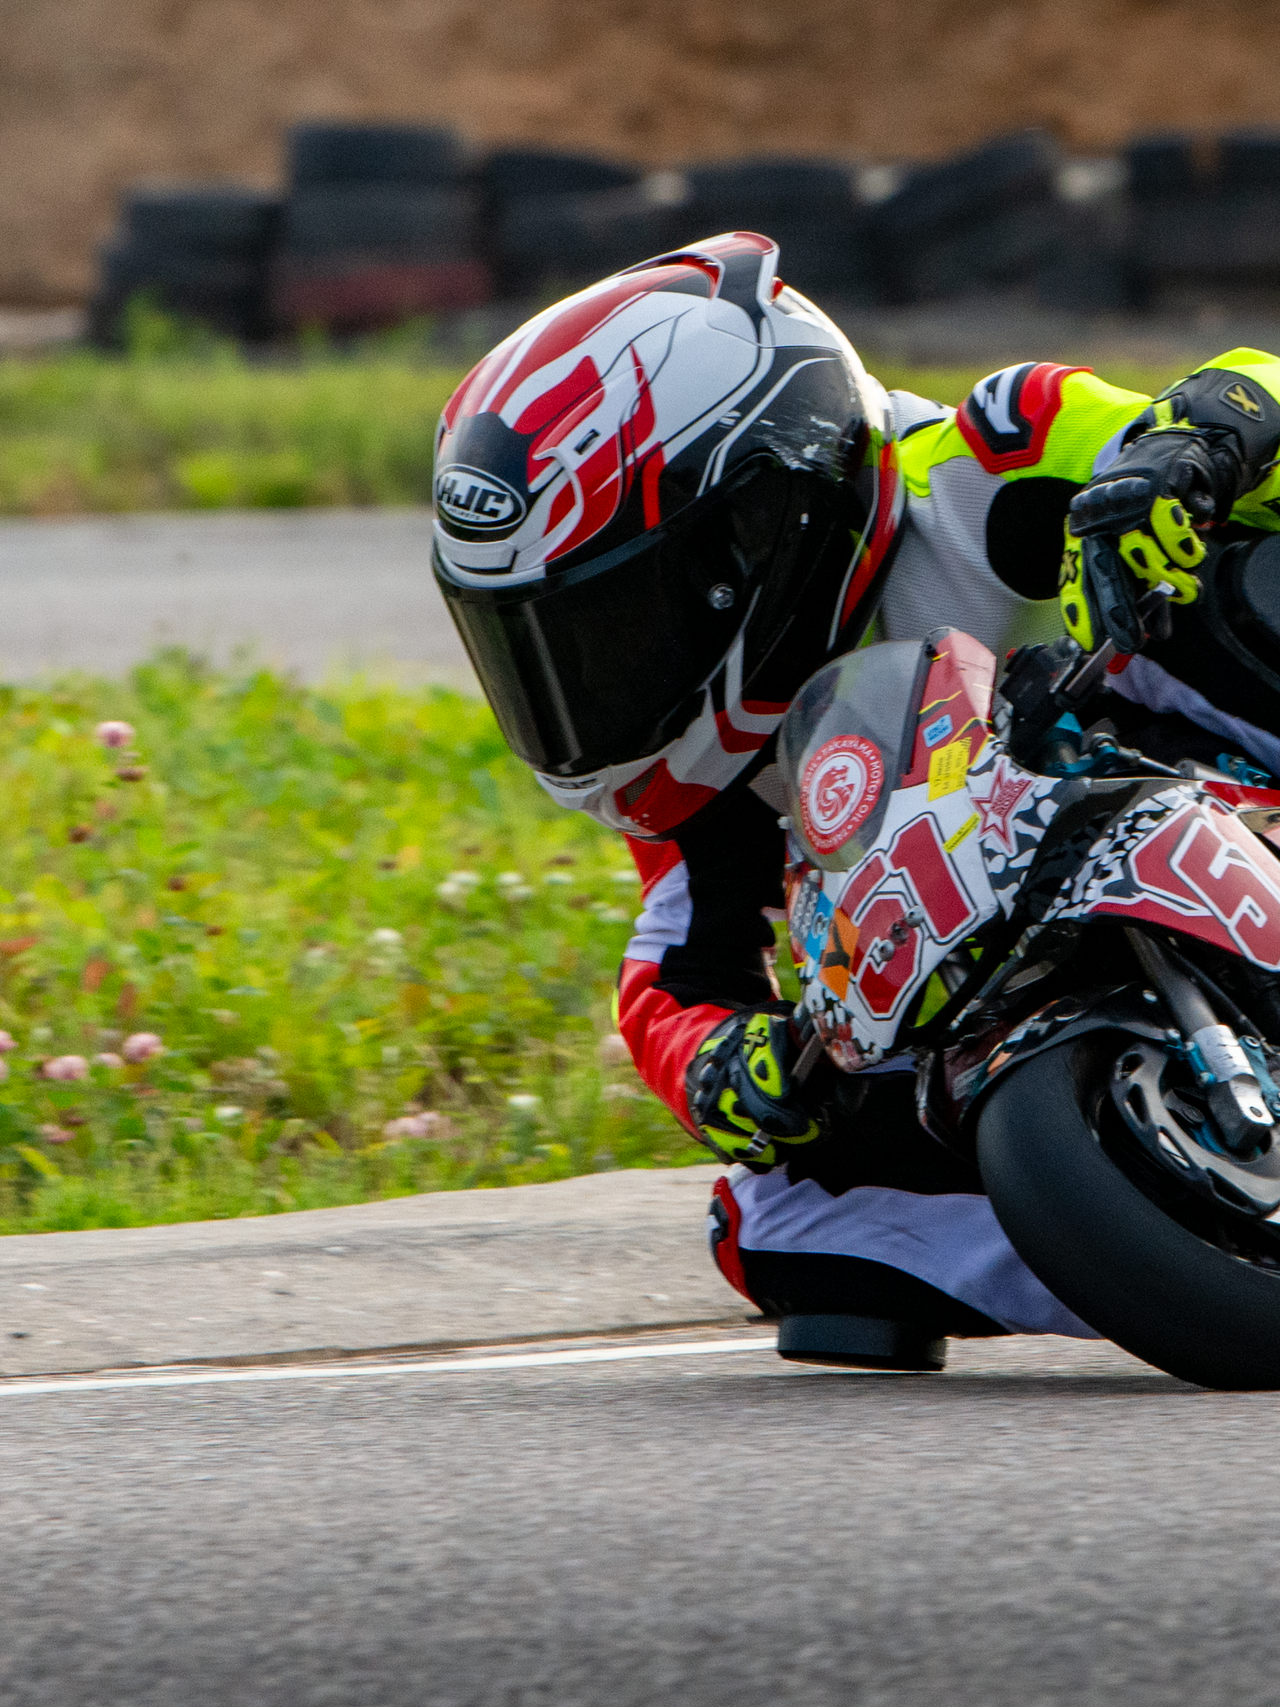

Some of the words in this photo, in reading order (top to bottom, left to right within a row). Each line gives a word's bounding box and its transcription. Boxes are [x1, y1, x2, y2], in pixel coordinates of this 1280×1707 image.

[438, 476, 509, 518] HJC
[864, 760, 882, 802] MOTOR
[851, 804, 869, 823] OIL
[839, 812, 978, 1021] 51
